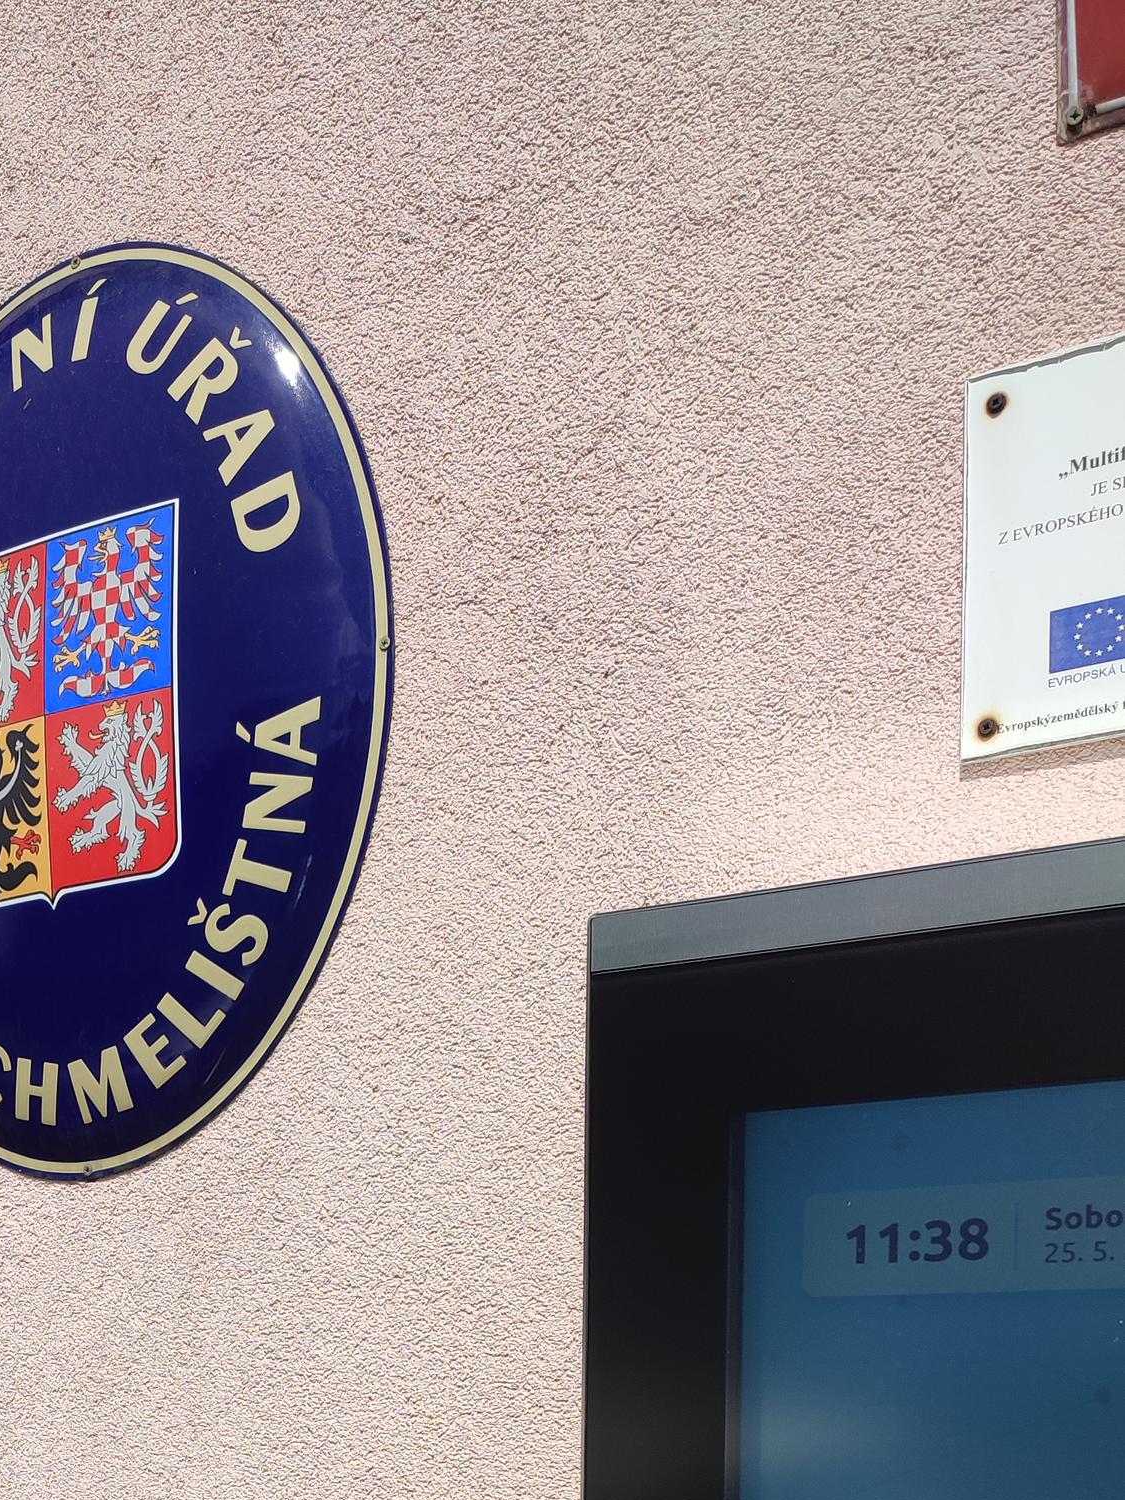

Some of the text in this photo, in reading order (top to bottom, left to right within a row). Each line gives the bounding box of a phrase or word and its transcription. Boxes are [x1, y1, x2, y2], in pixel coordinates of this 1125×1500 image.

[126, 292, 302, 553] ÚŘAD
[1090, 475, 1125, 497] JE S
[998, 503, 1124, 545] Z EVROPSKÉHO
[1047, 664, 1117, 688] EVROPSKÁ
[1044, 1204, 1124, 1231] Sobo
[846, 1217, 989, 1264] 11:38
[1043, 1241, 1115, 1264] 25. 5.
